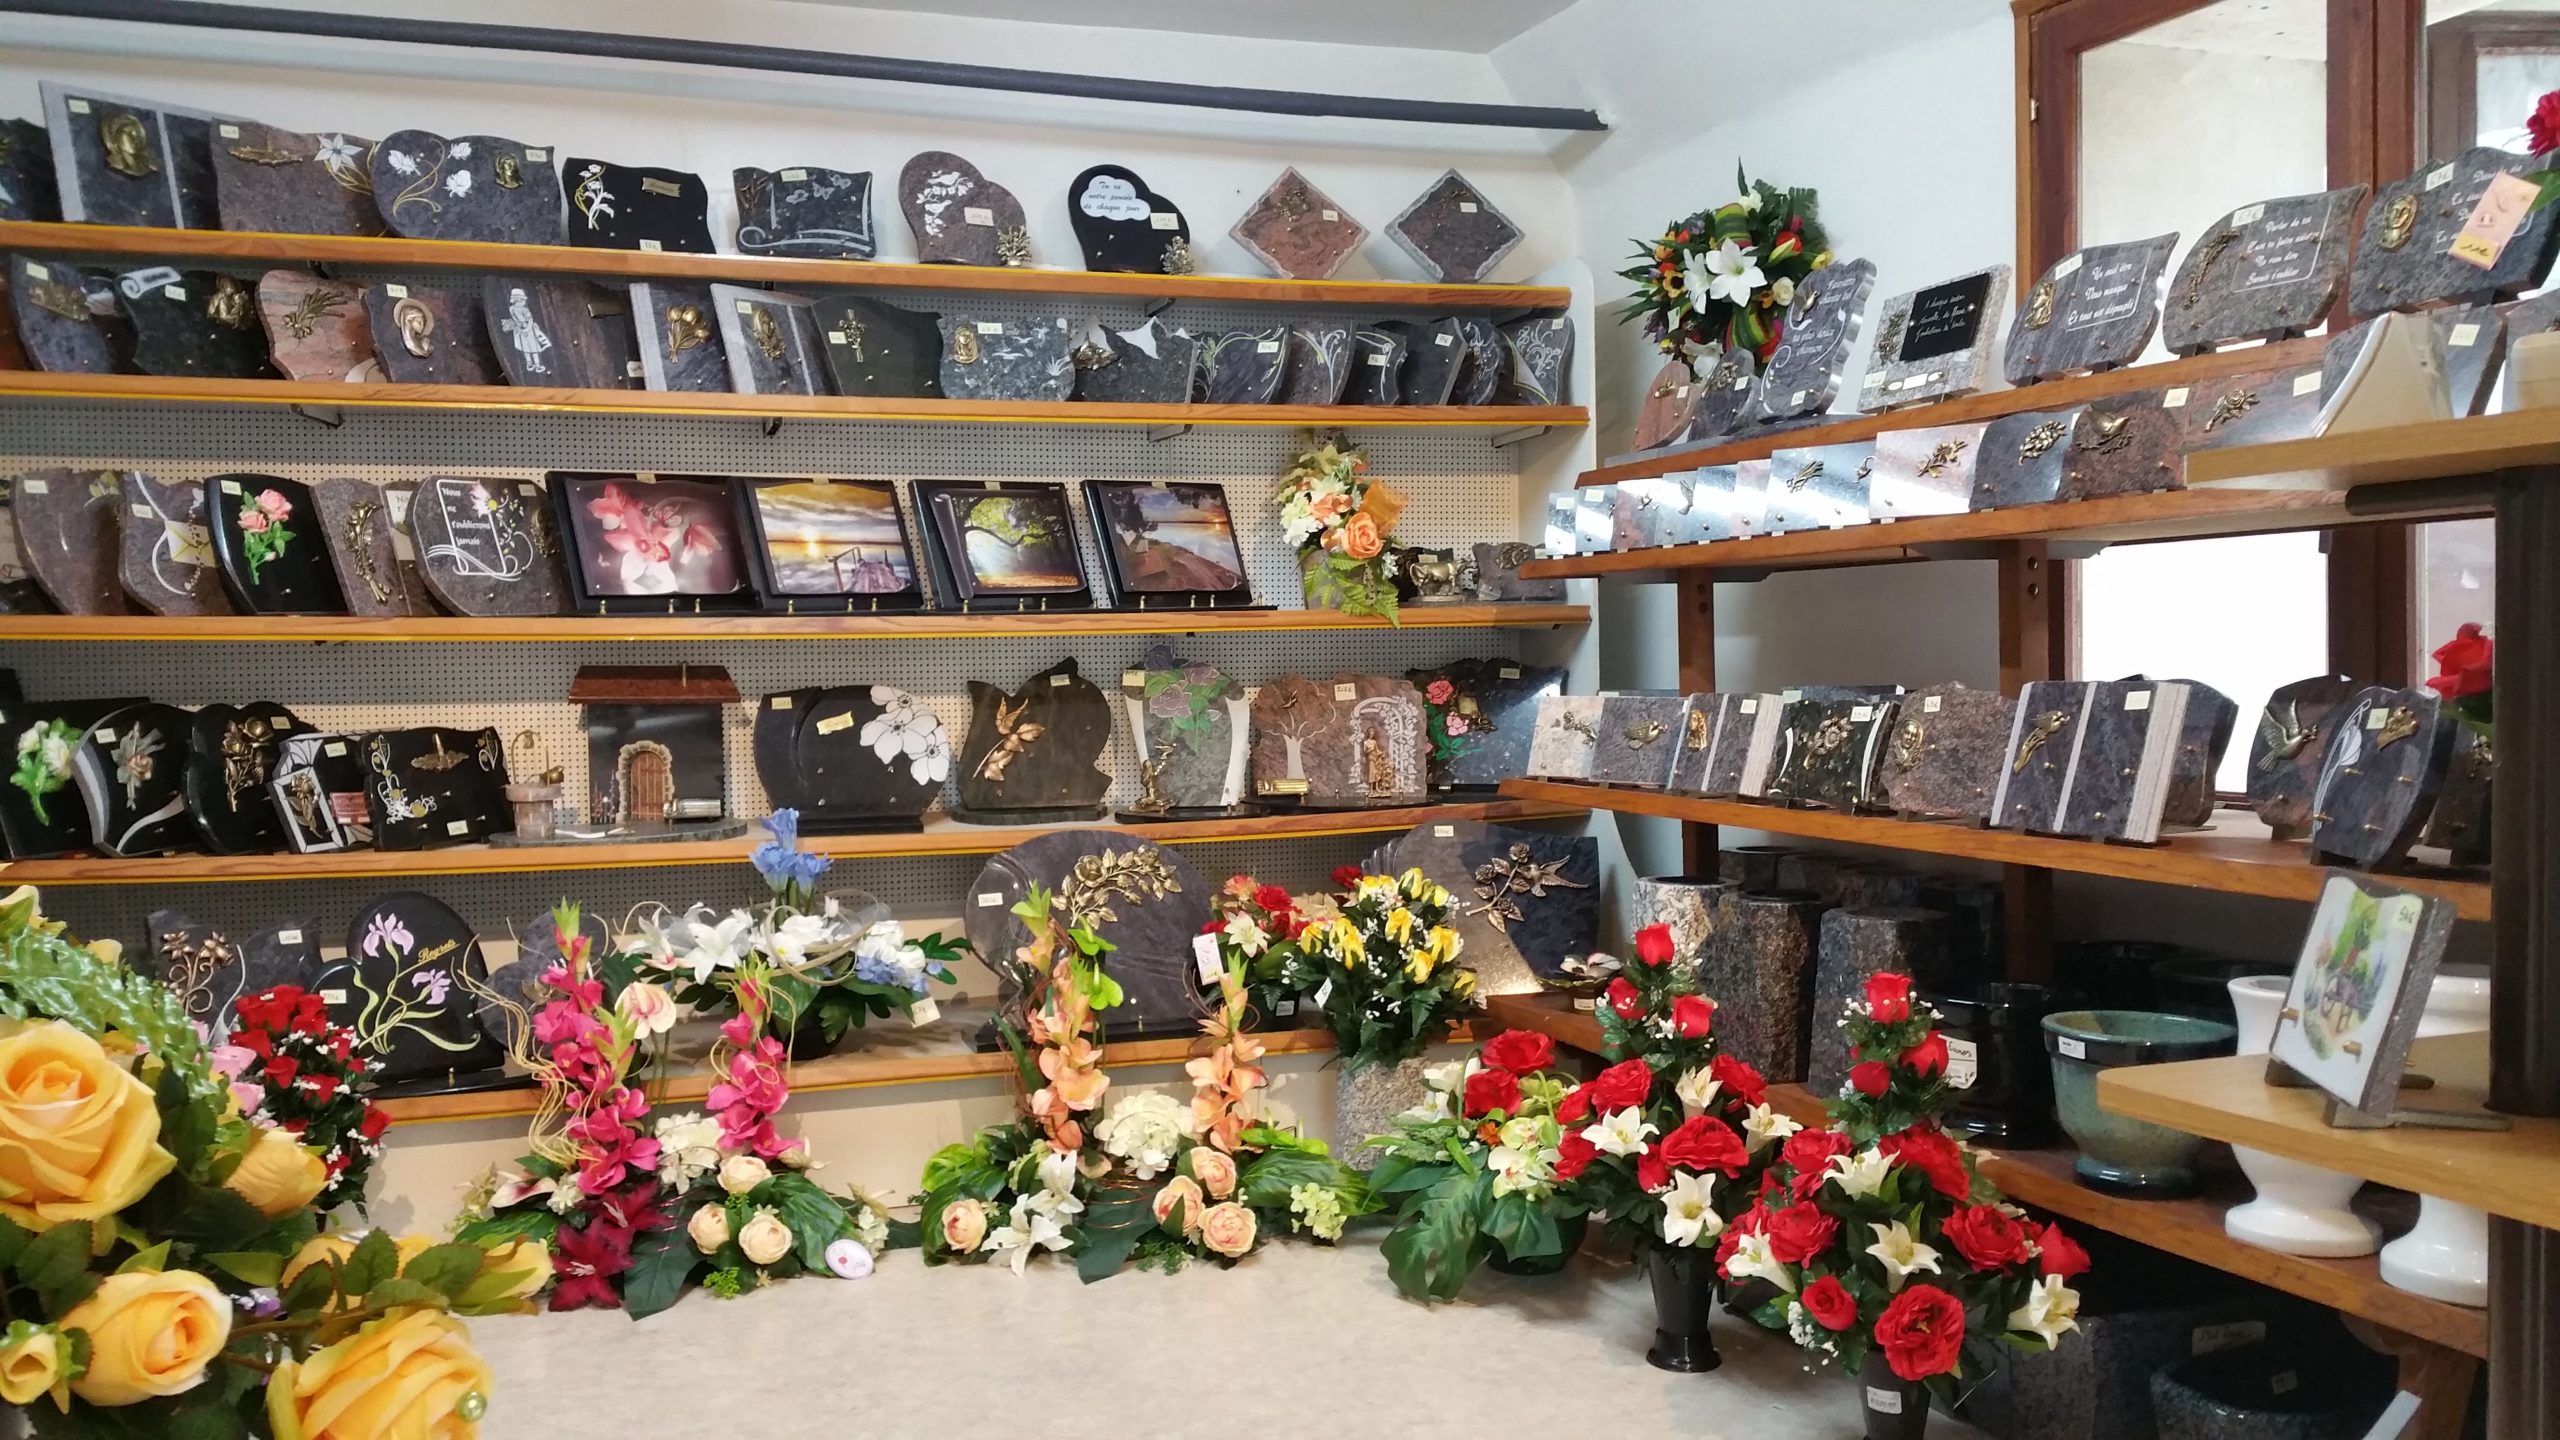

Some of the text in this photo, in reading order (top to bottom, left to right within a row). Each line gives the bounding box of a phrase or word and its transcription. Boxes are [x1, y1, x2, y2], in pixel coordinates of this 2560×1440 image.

[1099, 181, 1109, 190] Tu
[1096, 203, 1121, 213] chaque
[1125, 204, 1141, 213] jour
[441, 487, 461, 497] Nous
[446, 505, 457, 513] ne
[418, 938, 456, 963] Regrets
